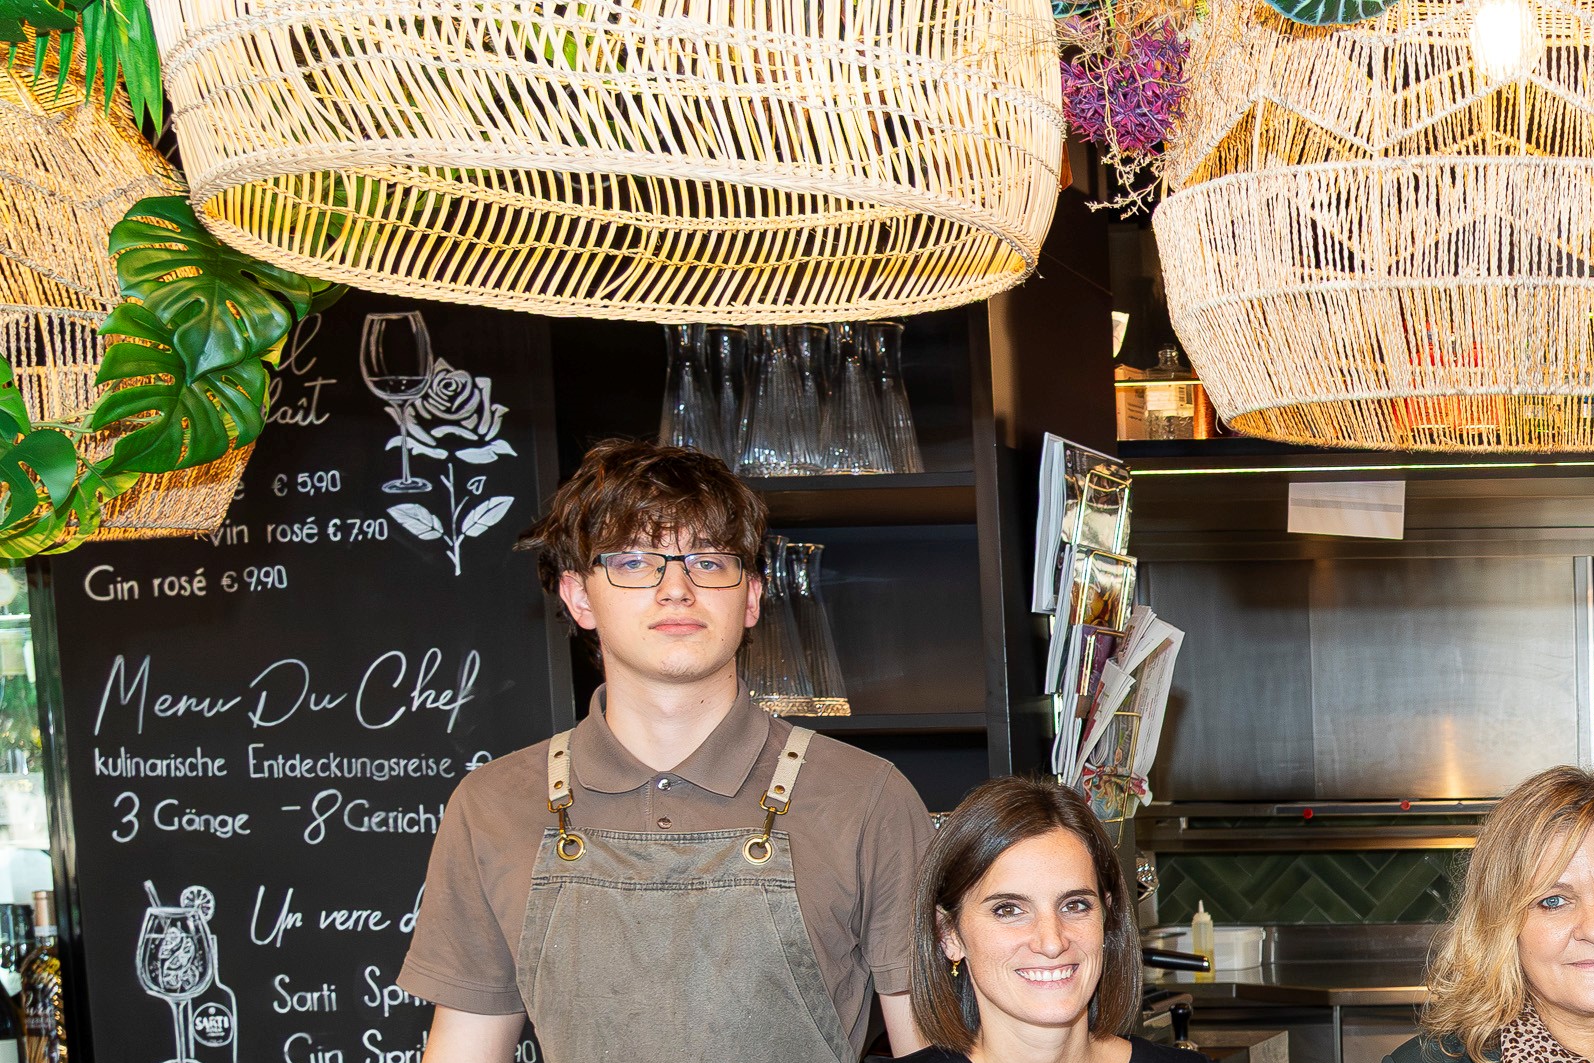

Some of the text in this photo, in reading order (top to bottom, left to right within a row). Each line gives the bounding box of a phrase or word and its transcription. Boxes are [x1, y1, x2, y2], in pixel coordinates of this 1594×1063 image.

[297, 470, 341, 496] 5,90
[266, 517, 319, 544] rosé
[84, 565, 140, 601] Gin
[153, 567, 207, 598] rosé
[94, 648, 481, 736] Menu Du Chef
[94, 746, 228, 778] kulinarische
[248, 743, 456, 781] Entdeckungsreise
[112, 791, 140, 843] 3
[153, 798, 251, 838] Gänge
[319, 909, 391, 932] verre
[273, 973, 338, 1014] Sarti
